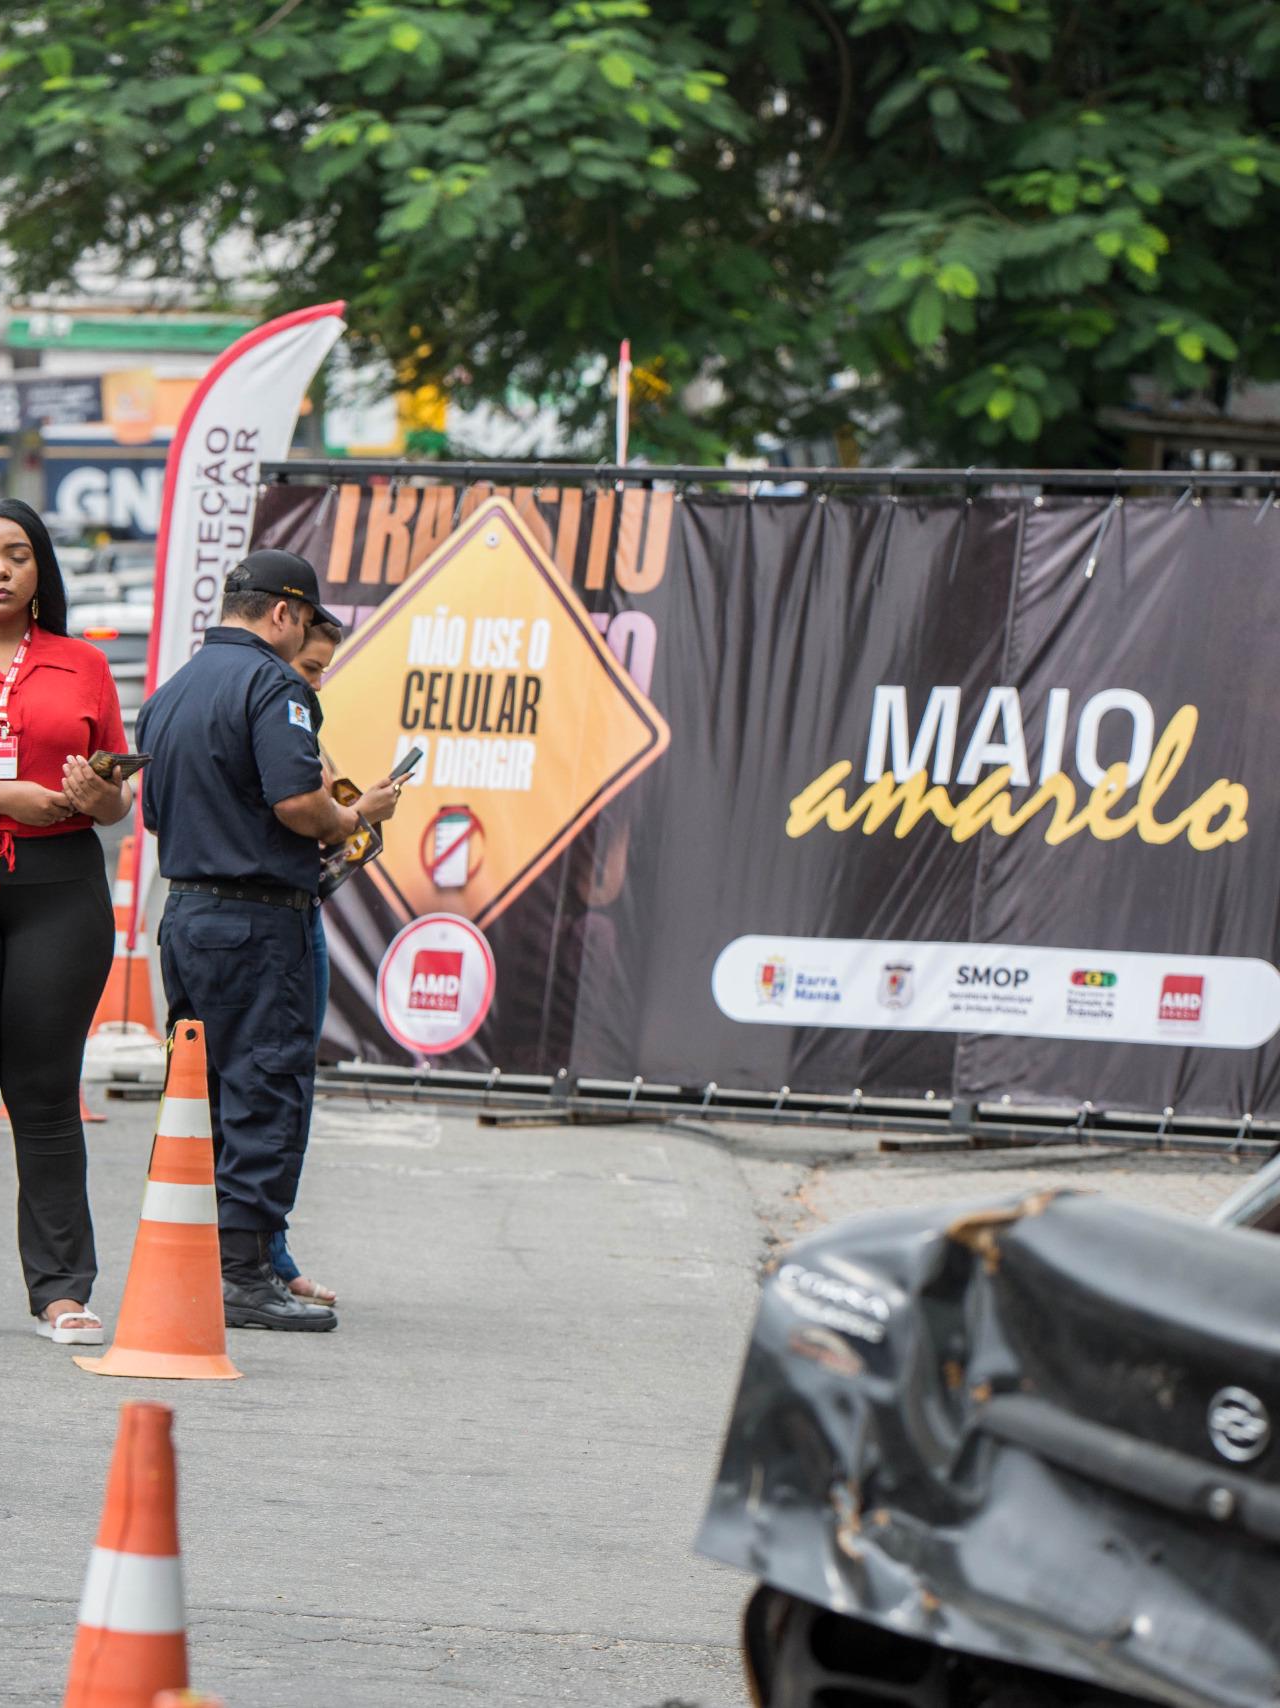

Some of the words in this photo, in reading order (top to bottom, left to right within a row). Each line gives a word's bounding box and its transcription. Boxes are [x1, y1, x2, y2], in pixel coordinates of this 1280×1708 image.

[407, 604, 467, 668] NÃO
[469, 616, 525, 669] USE
[527, 618, 552, 671] O
[400, 670, 542, 735] CELULAR
[432, 736, 536, 792] DIRIGIR
[864, 685, 1155, 791] MAIO
[786, 705, 1250, 851] amarelo
[412, 972, 460, 997] AMD
[796, 973, 838, 987] Barra
[956, 965, 1029, 988] SMOP
[1161, 991, 1201, 1010] AMD
